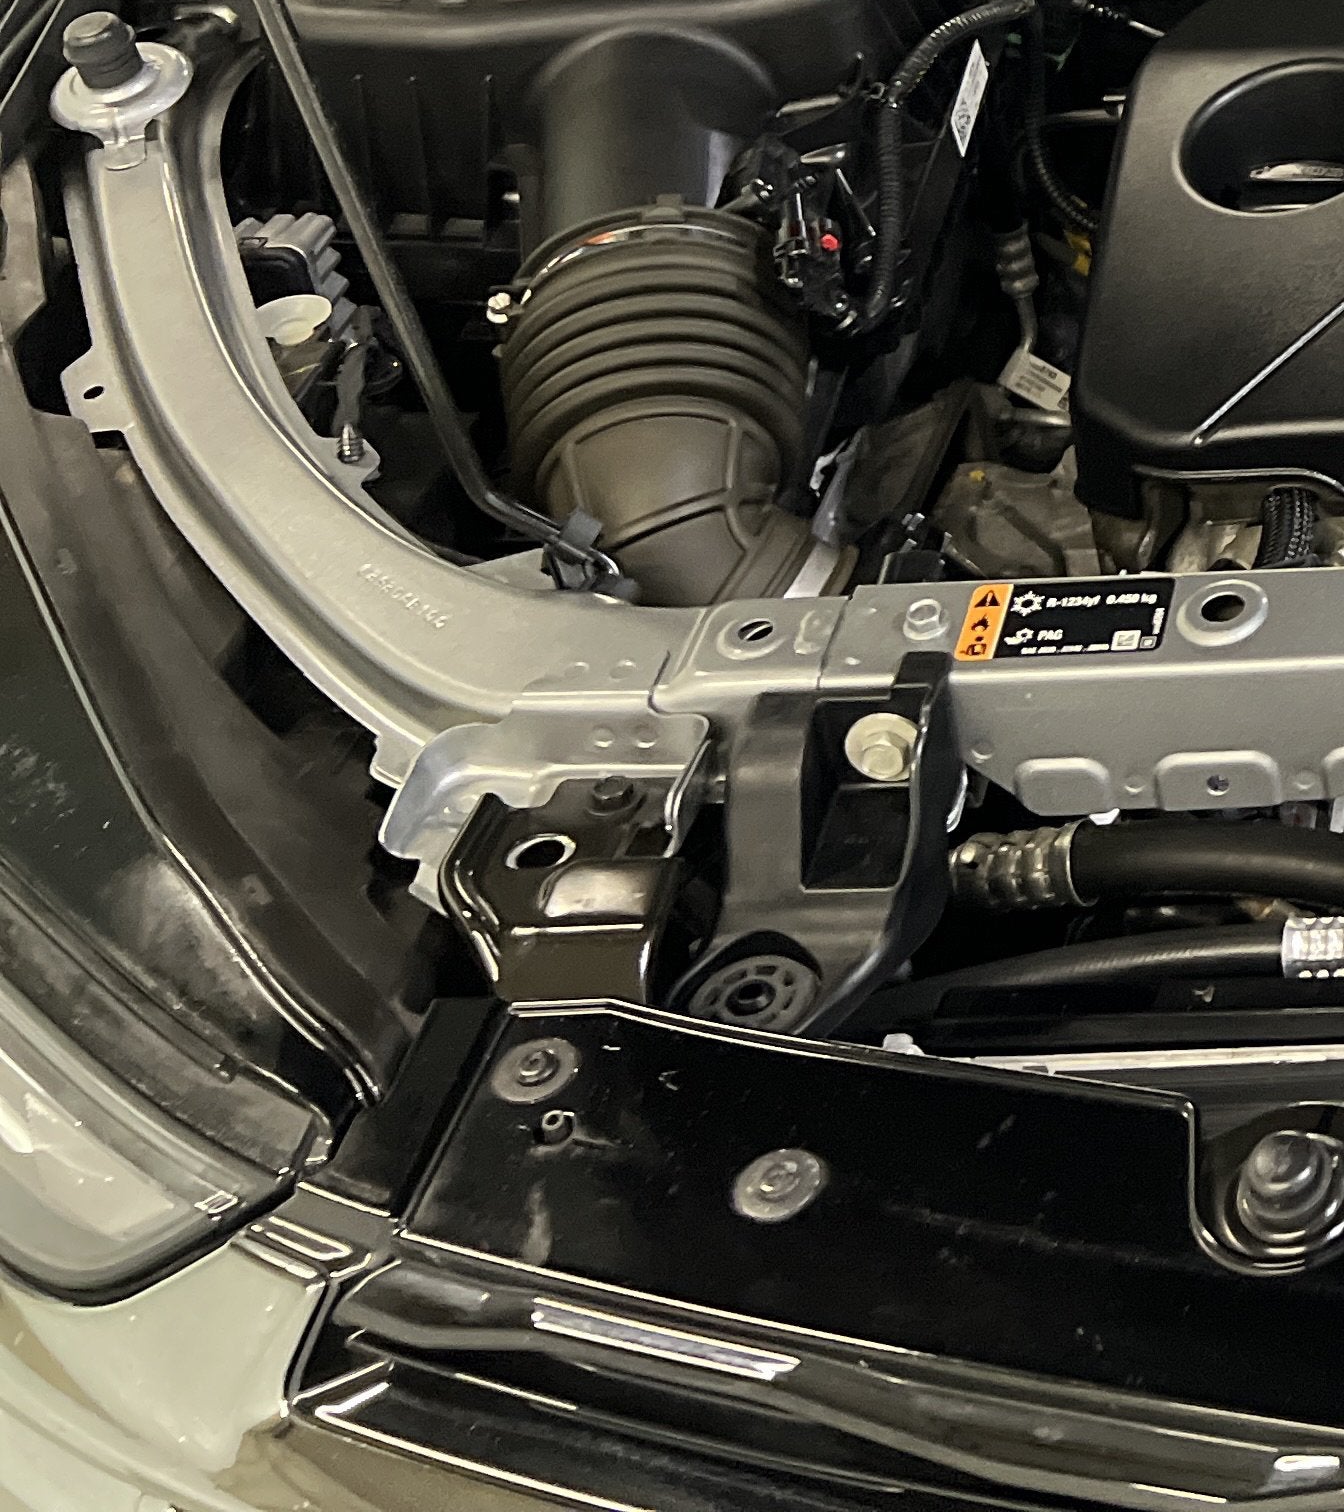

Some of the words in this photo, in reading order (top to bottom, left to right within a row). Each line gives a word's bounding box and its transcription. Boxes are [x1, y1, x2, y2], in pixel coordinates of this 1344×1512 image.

[1046, 594, 1101, 608] R-1234yf
[1140, 593, 1158, 605] kg
[1037, 629, 1064, 641] PAG
